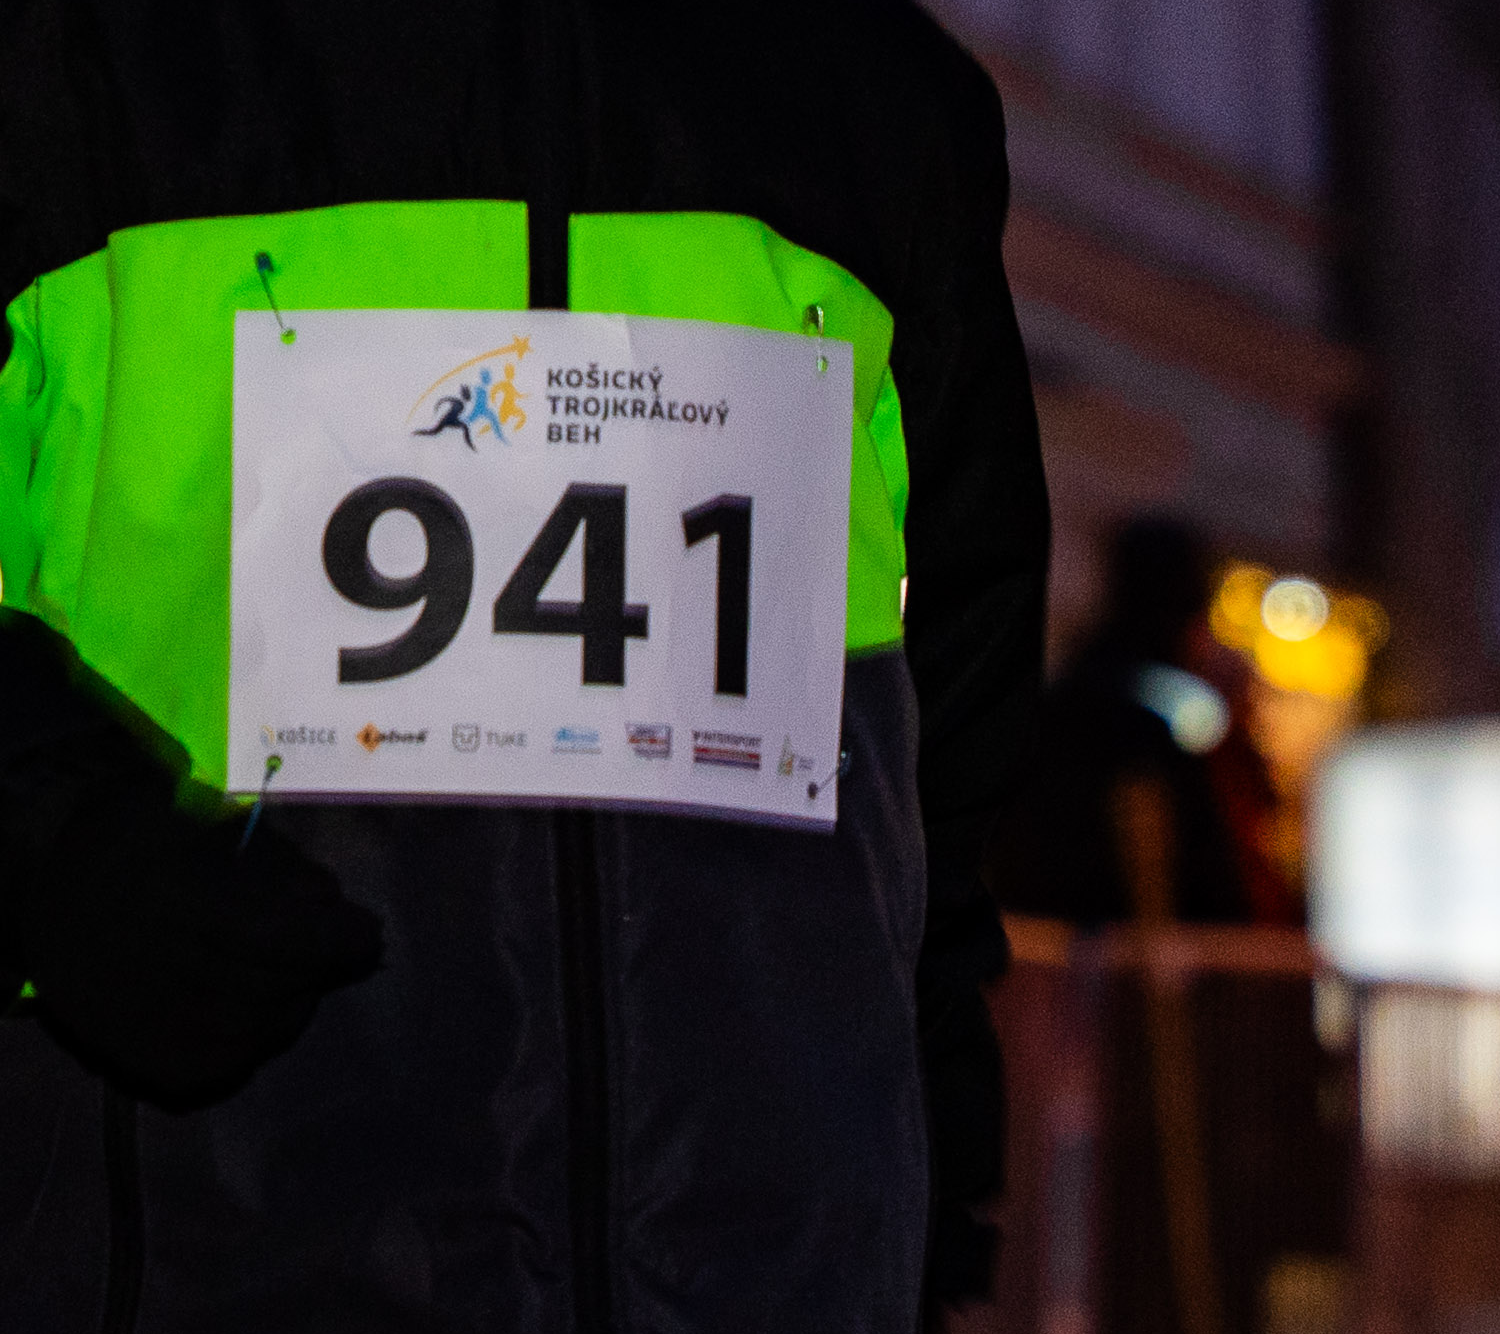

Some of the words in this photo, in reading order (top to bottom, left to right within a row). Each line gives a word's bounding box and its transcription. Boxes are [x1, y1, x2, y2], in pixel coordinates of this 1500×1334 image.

[547, 363, 664, 392] KOŠICKÝ
[547, 423, 601, 444] BEH
[321, 476, 754, 699] 941
